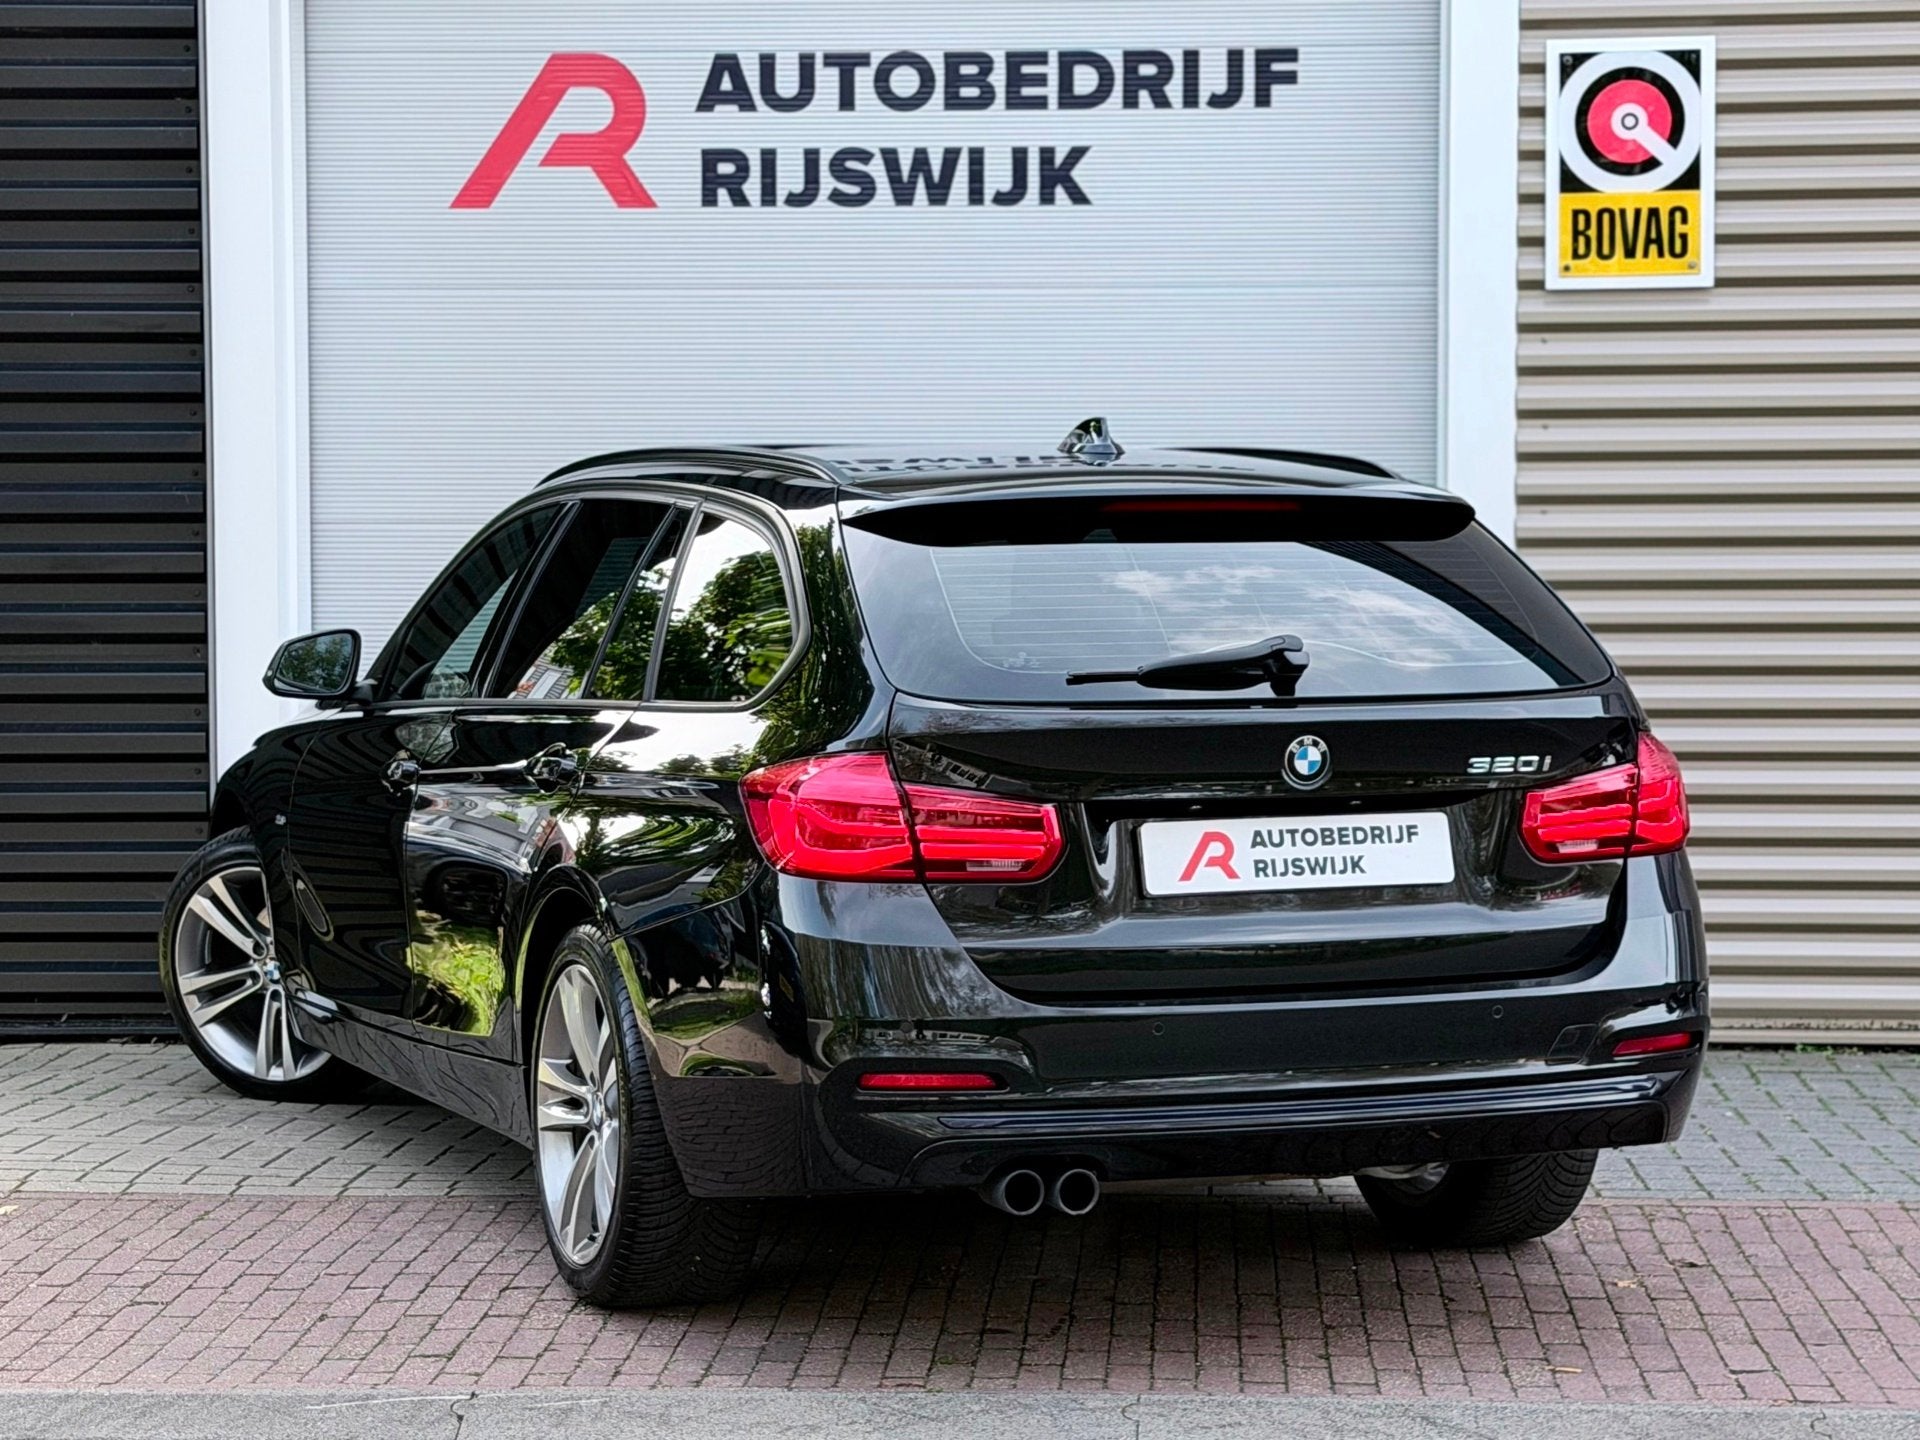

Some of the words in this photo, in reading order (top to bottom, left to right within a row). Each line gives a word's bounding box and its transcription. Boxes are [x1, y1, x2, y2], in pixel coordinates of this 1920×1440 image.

[696, 47, 1298, 112] AUTOBEDRIJF
[700, 146, 1092, 207] RIJSWIJK
[1571, 205, 1689, 260] BOVAG
[1291, 736, 1326, 753] BMW
[1466, 755, 1552, 775] 320i
[1250, 824, 1419, 849] AUTOBEDRIJF
[1253, 855, 1367, 878] RIJSWIJK
